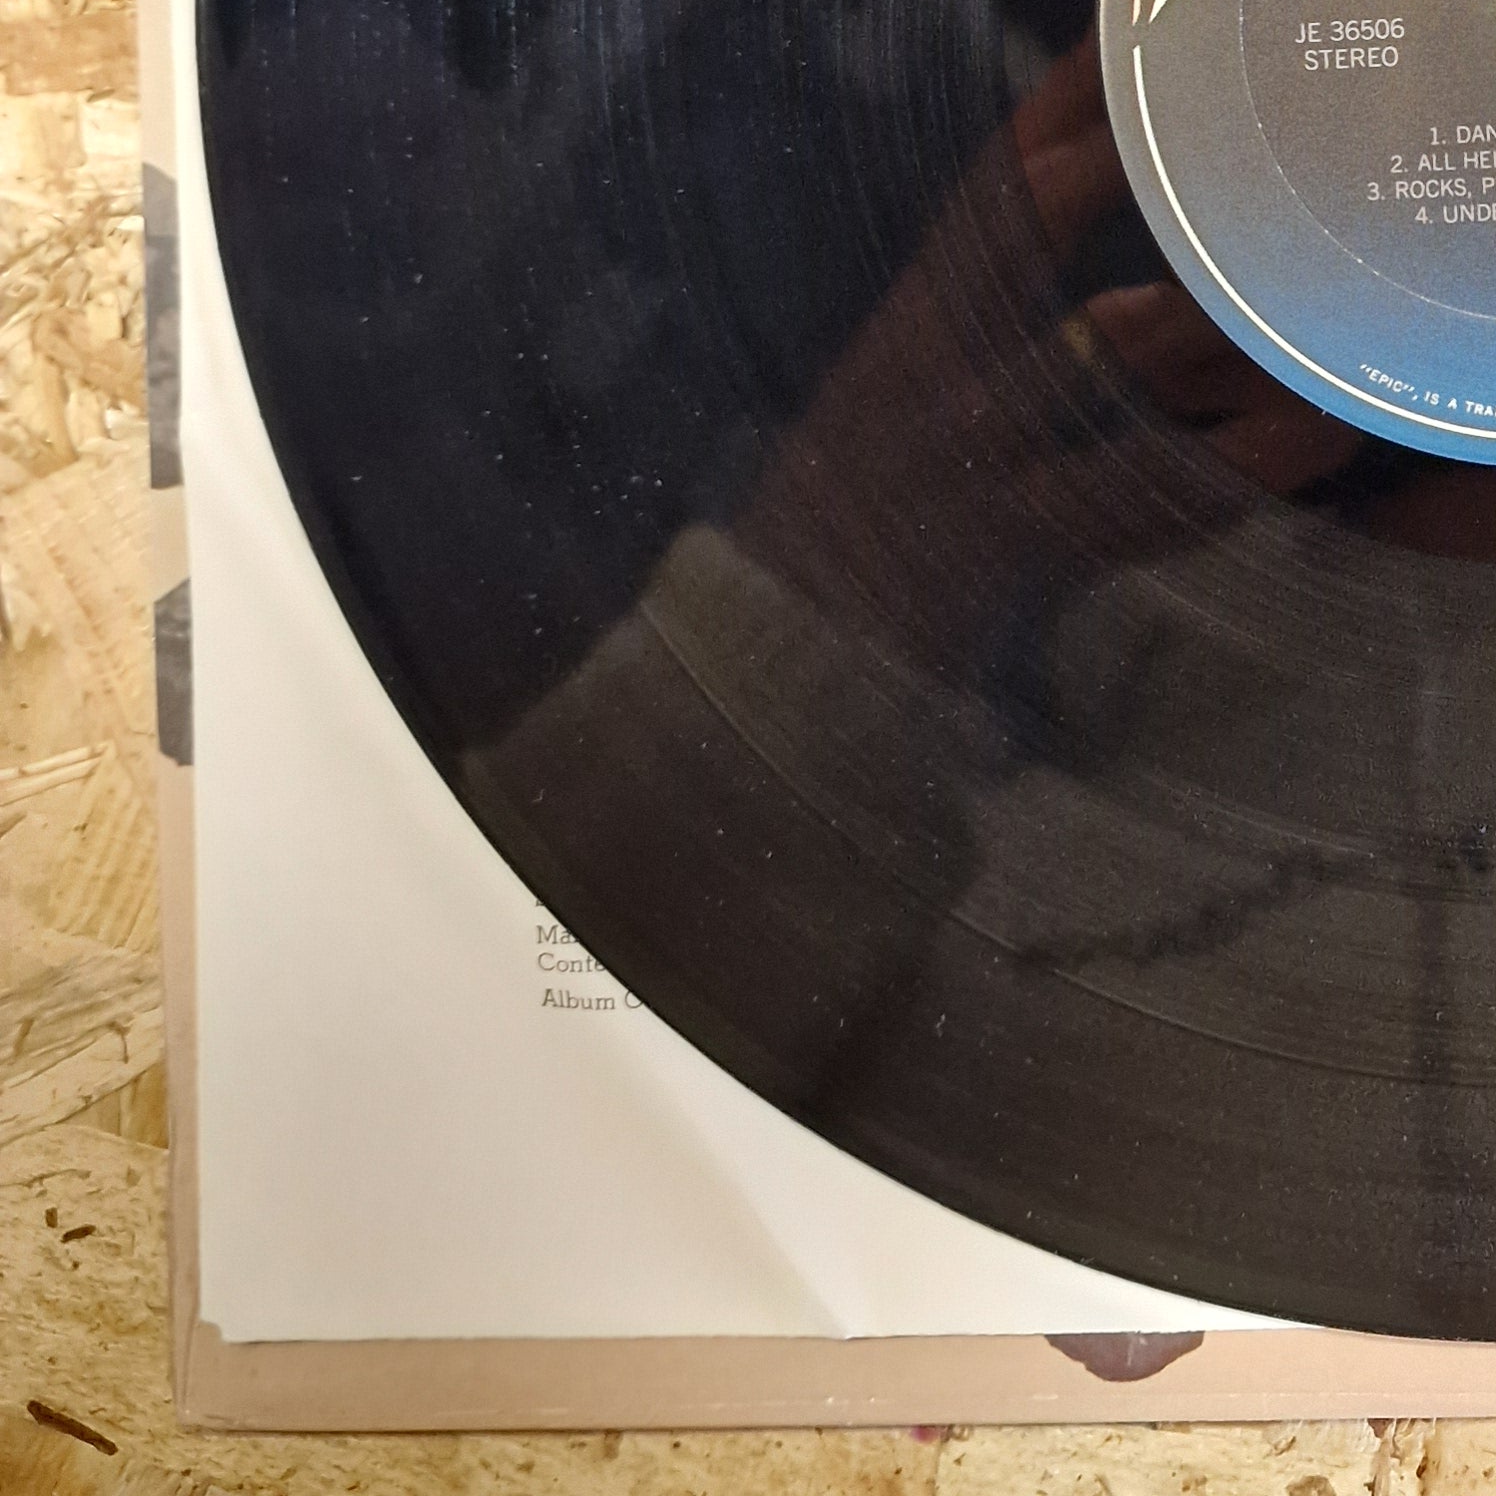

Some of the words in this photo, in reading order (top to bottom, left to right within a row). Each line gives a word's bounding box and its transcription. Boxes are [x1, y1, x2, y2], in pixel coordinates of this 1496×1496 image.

[1294, 22, 1322, 44] JE
[1330, 17, 1405, 42] 36506
[1303, 45, 1399, 72] STEREO
[1429, 127, 1447, 146] 1.
[1390, 154, 1409, 174] 2.
[1417, 154, 1457, 172] ALL
[1367, 182, 1387, 201] 3.
[1395, 177, 1473, 200] ROCKS,
[1415, 206, 1435, 225] 4.
[1423, 390, 1441, 407] IS
[1447, 397, 1459, 410] A
[542, 988, 616, 1010] Album
